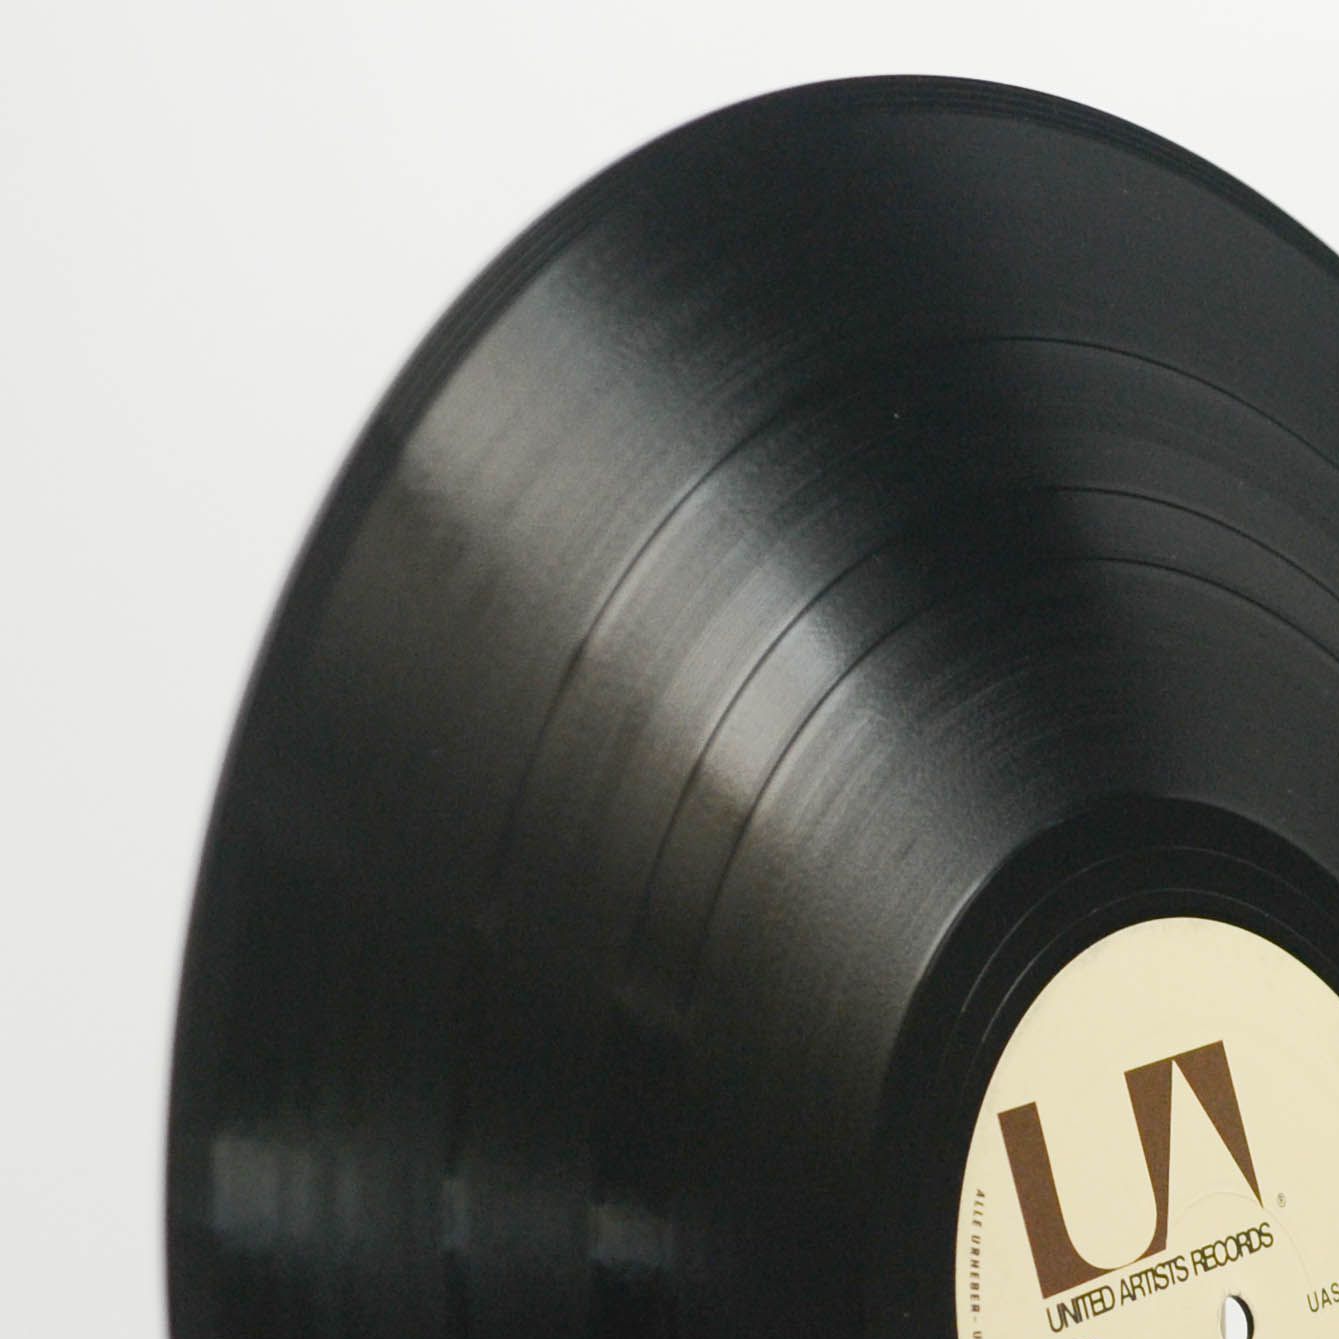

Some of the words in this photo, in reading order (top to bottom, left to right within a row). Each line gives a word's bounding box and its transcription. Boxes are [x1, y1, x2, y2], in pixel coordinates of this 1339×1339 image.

[972, 1188, 985, 1227] ALLE
[1046, 1285, 1115, 1333] UNITED
[1120, 1255, 1189, 1306] ARTISTS
[1190, 1222, 1273, 1276] RECORDS
